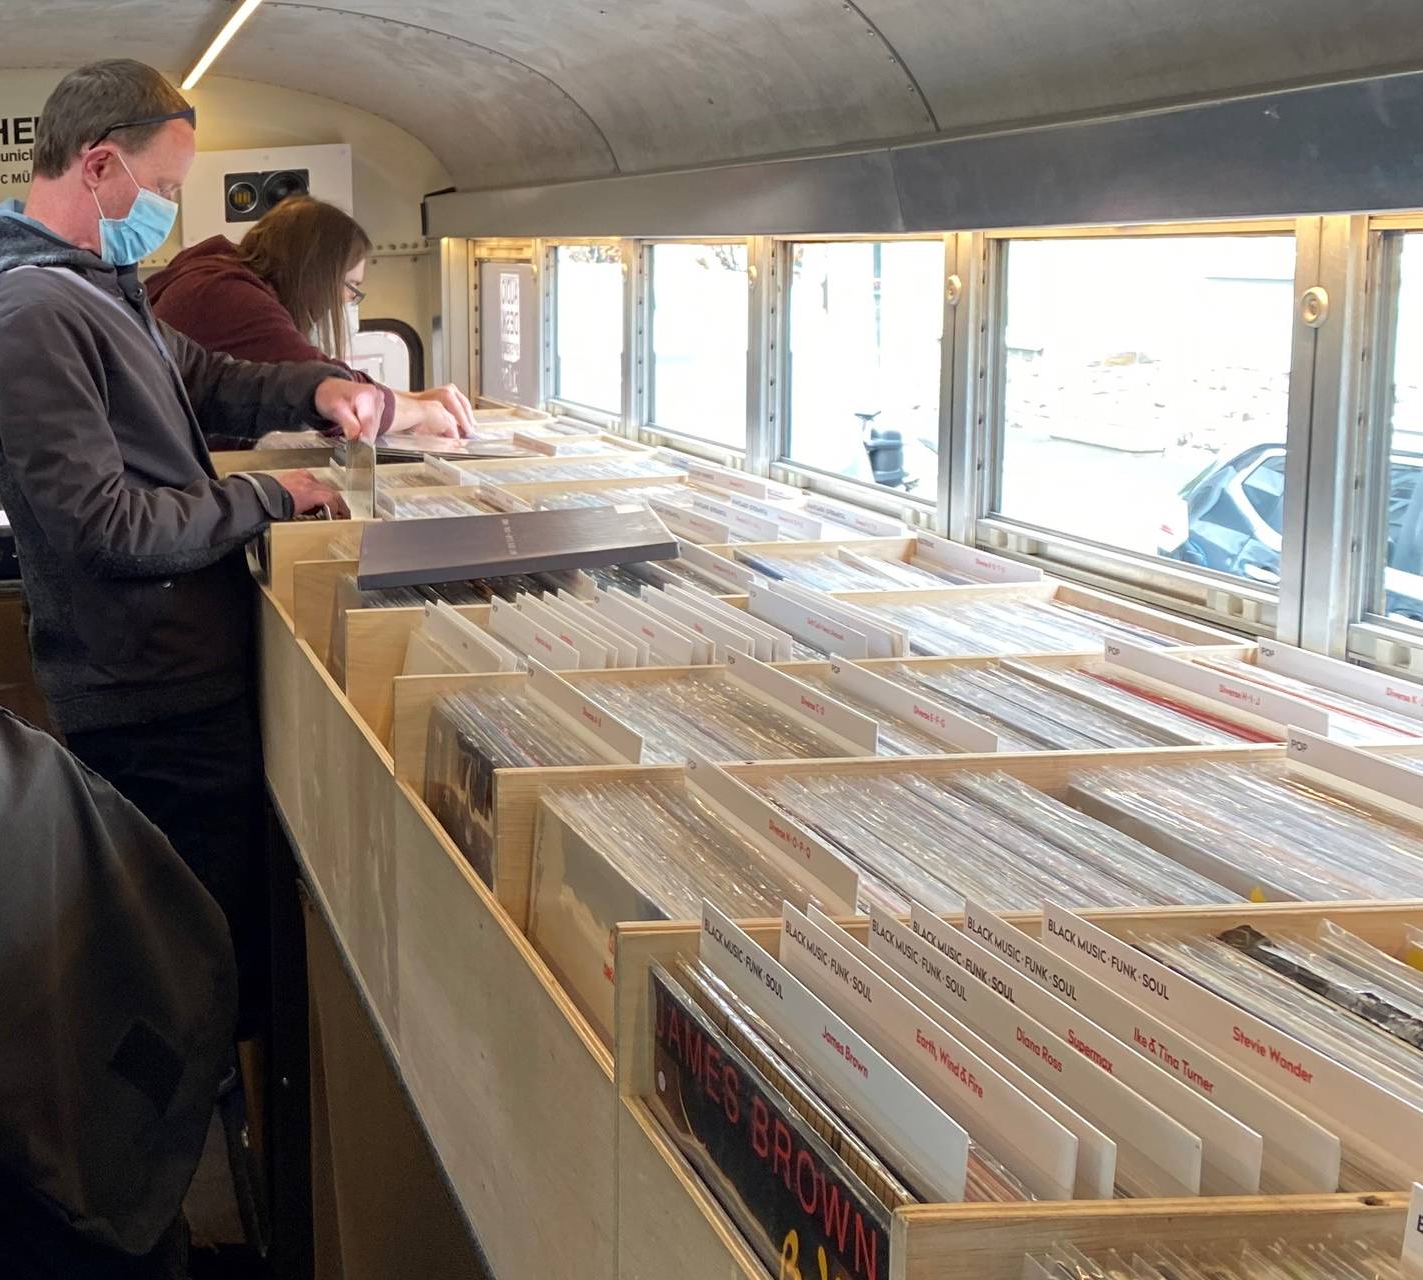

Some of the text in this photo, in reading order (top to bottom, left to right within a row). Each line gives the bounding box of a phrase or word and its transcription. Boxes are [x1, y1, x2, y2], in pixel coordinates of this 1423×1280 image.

[13, 116, 42, 144] E
[11, 169, 33, 184] MÜ
[1290, 739, 1308, 753] POP
[704, 918, 784, 1000] BLACK MUSIC FUNK SOUL
[785, 919, 873, 1003] BLACK MUSIC FUNK SOUL
[871, 919, 968, 1002] BLACK MUSIC FUNK SOUL
[913, 919, 1015, 1003] BLACK MUSIC FUNK SOUL
[967, 916, 1077, 1001] BLACK MUSIC FUNK SOUL
[1047, 918, 1170, 1001] BLACK MUSIC FUNK SOUL
[821, 1025, 869, 1078] James Brown
[916, 1028, 938, 1060] Earth,
[939, 1046, 960, 1078] Wind
[967, 1073, 984, 1098] Fire
[1016, 1026, 1063, 1073] Diana Ross
[1067, 1029, 1114, 1074] Supermax
[1133, 1027, 1215, 1095] Ike & Tina Turner
[1232, 1025, 1314, 1085] Stevie Wonder
[656, 992, 739, 1124] JAMES
[751, 1094, 877, 1280] BROWN
